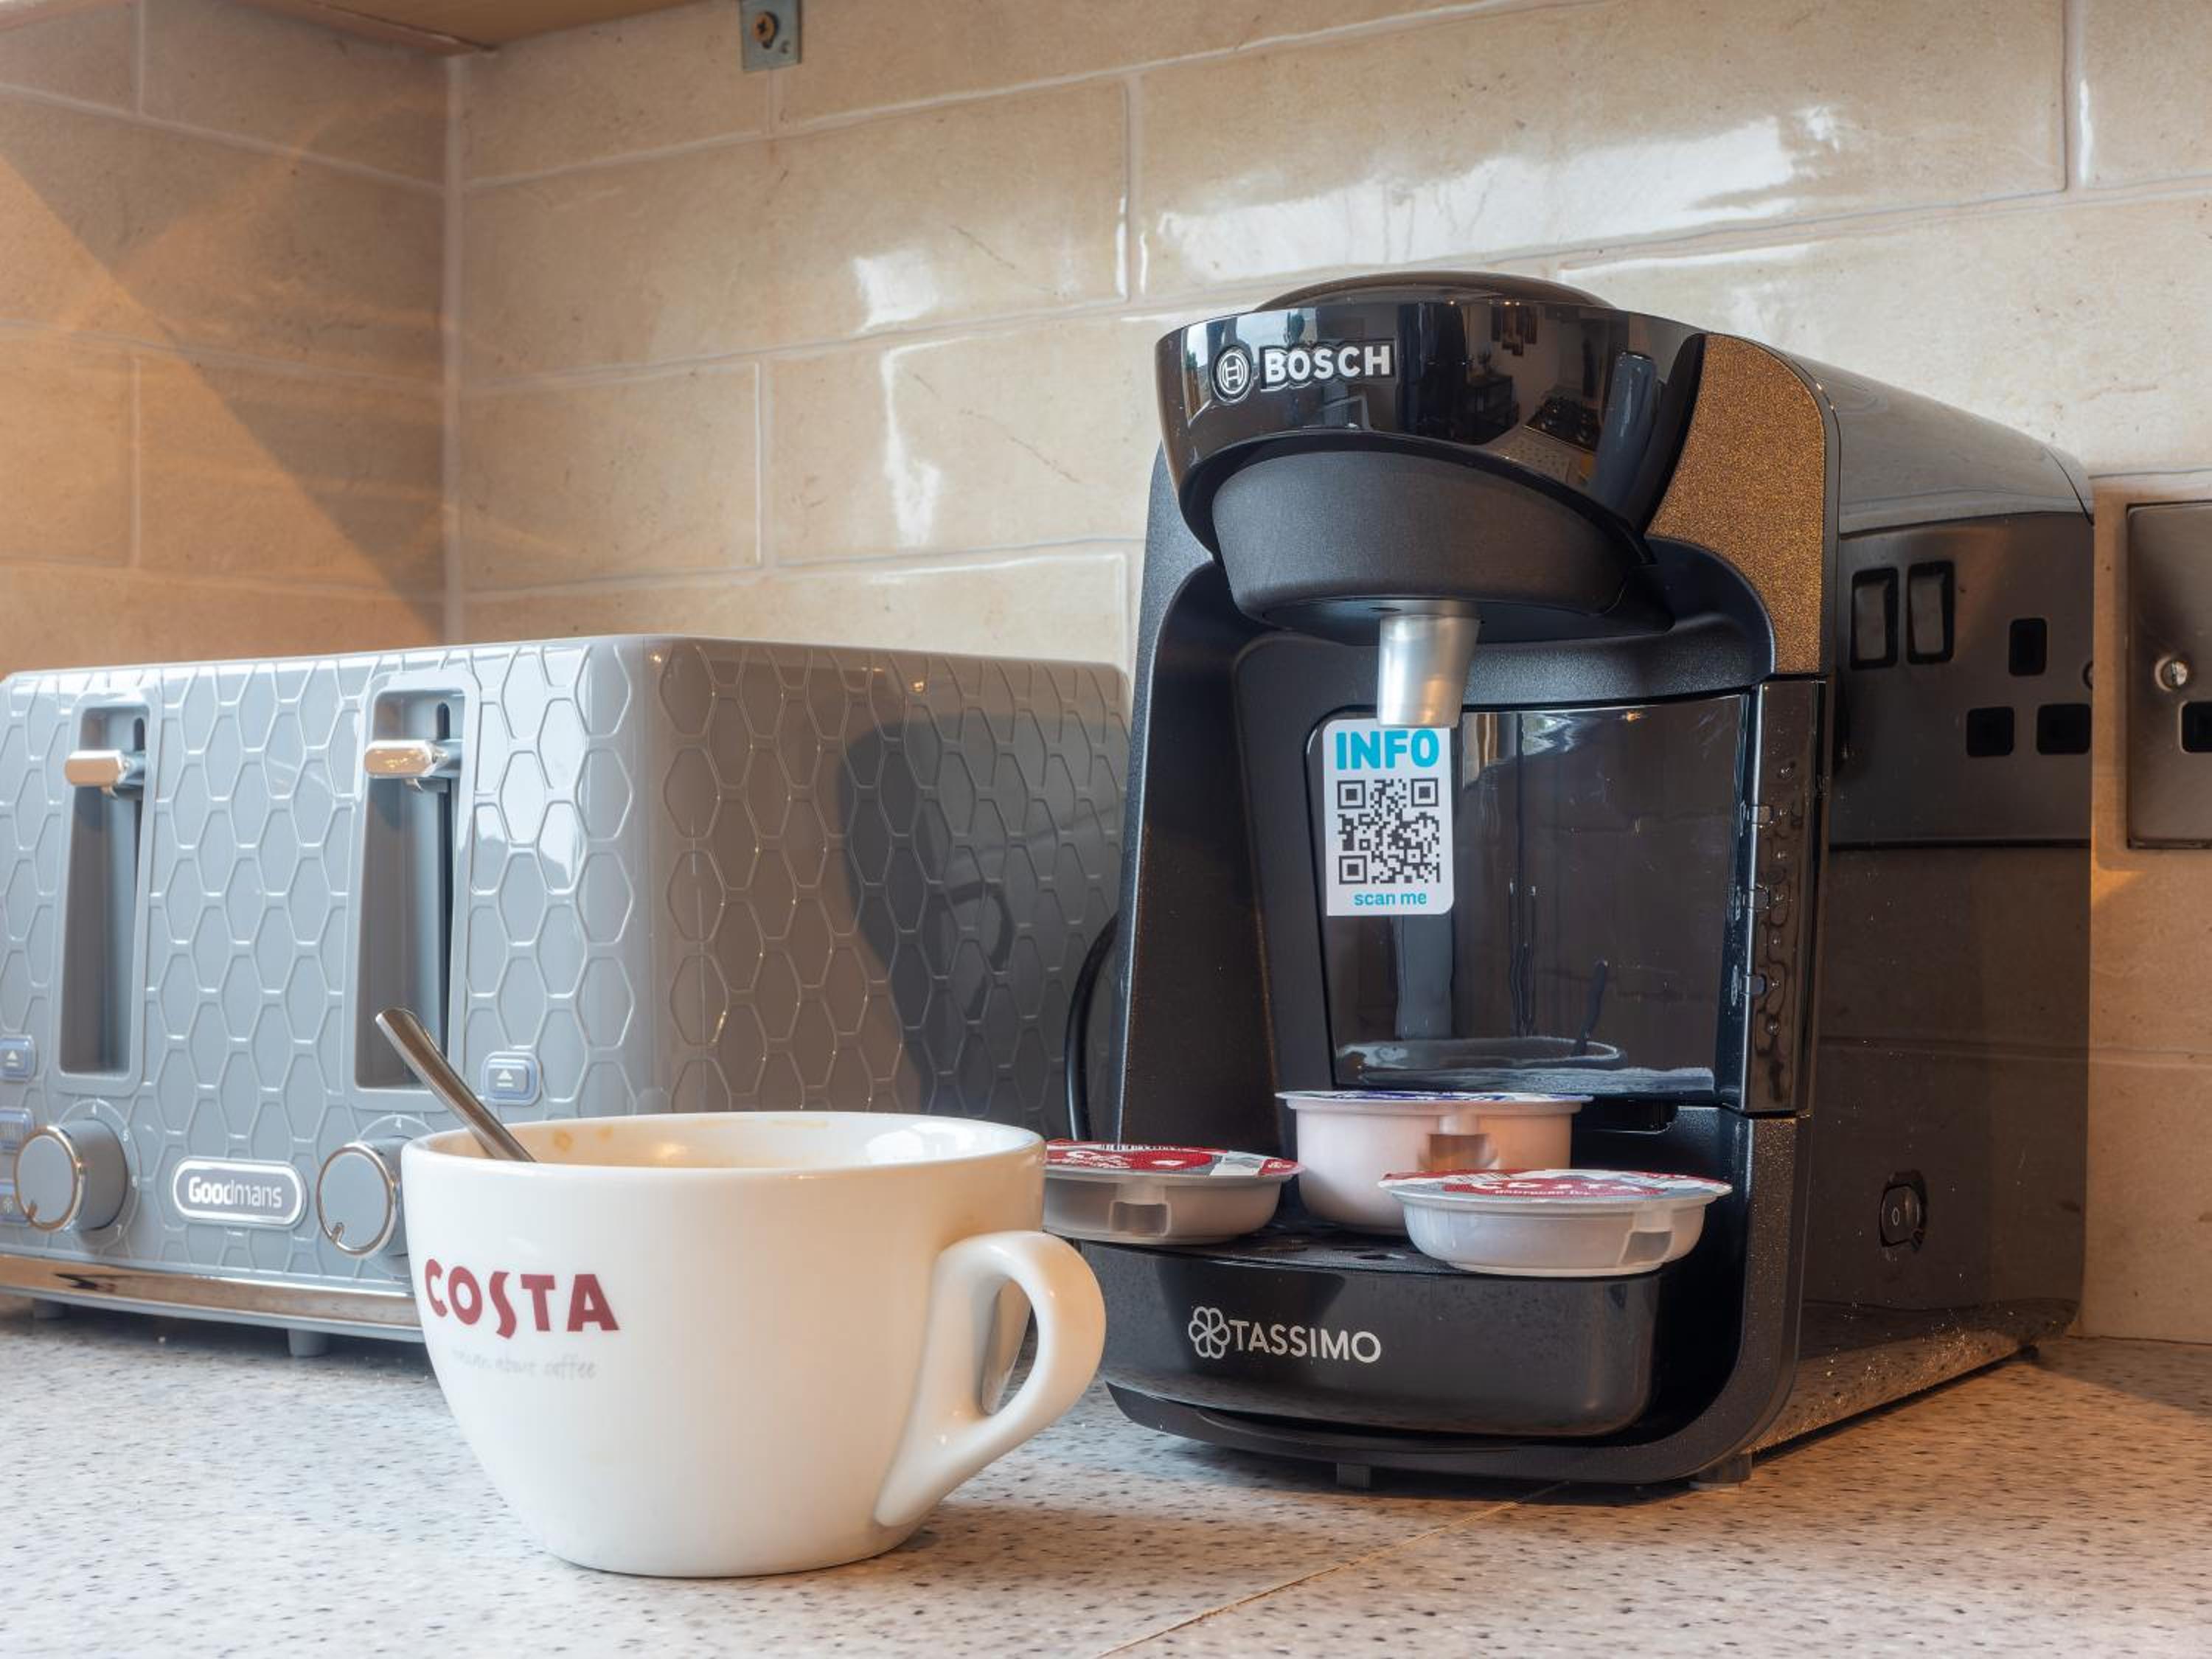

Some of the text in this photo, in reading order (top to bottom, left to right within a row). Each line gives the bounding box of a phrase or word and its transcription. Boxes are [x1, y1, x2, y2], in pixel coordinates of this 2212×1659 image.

[1265, 345, 1390, 383] BOSCH
[1335, 728, 1440, 771] INFO
[1354, 891, 1427, 906] scan me
[188, 1176, 283, 1208] Goodmans
[425, 1259, 620, 1339] COSTA
[1228, 1319, 1382, 1363] TASSIMO
